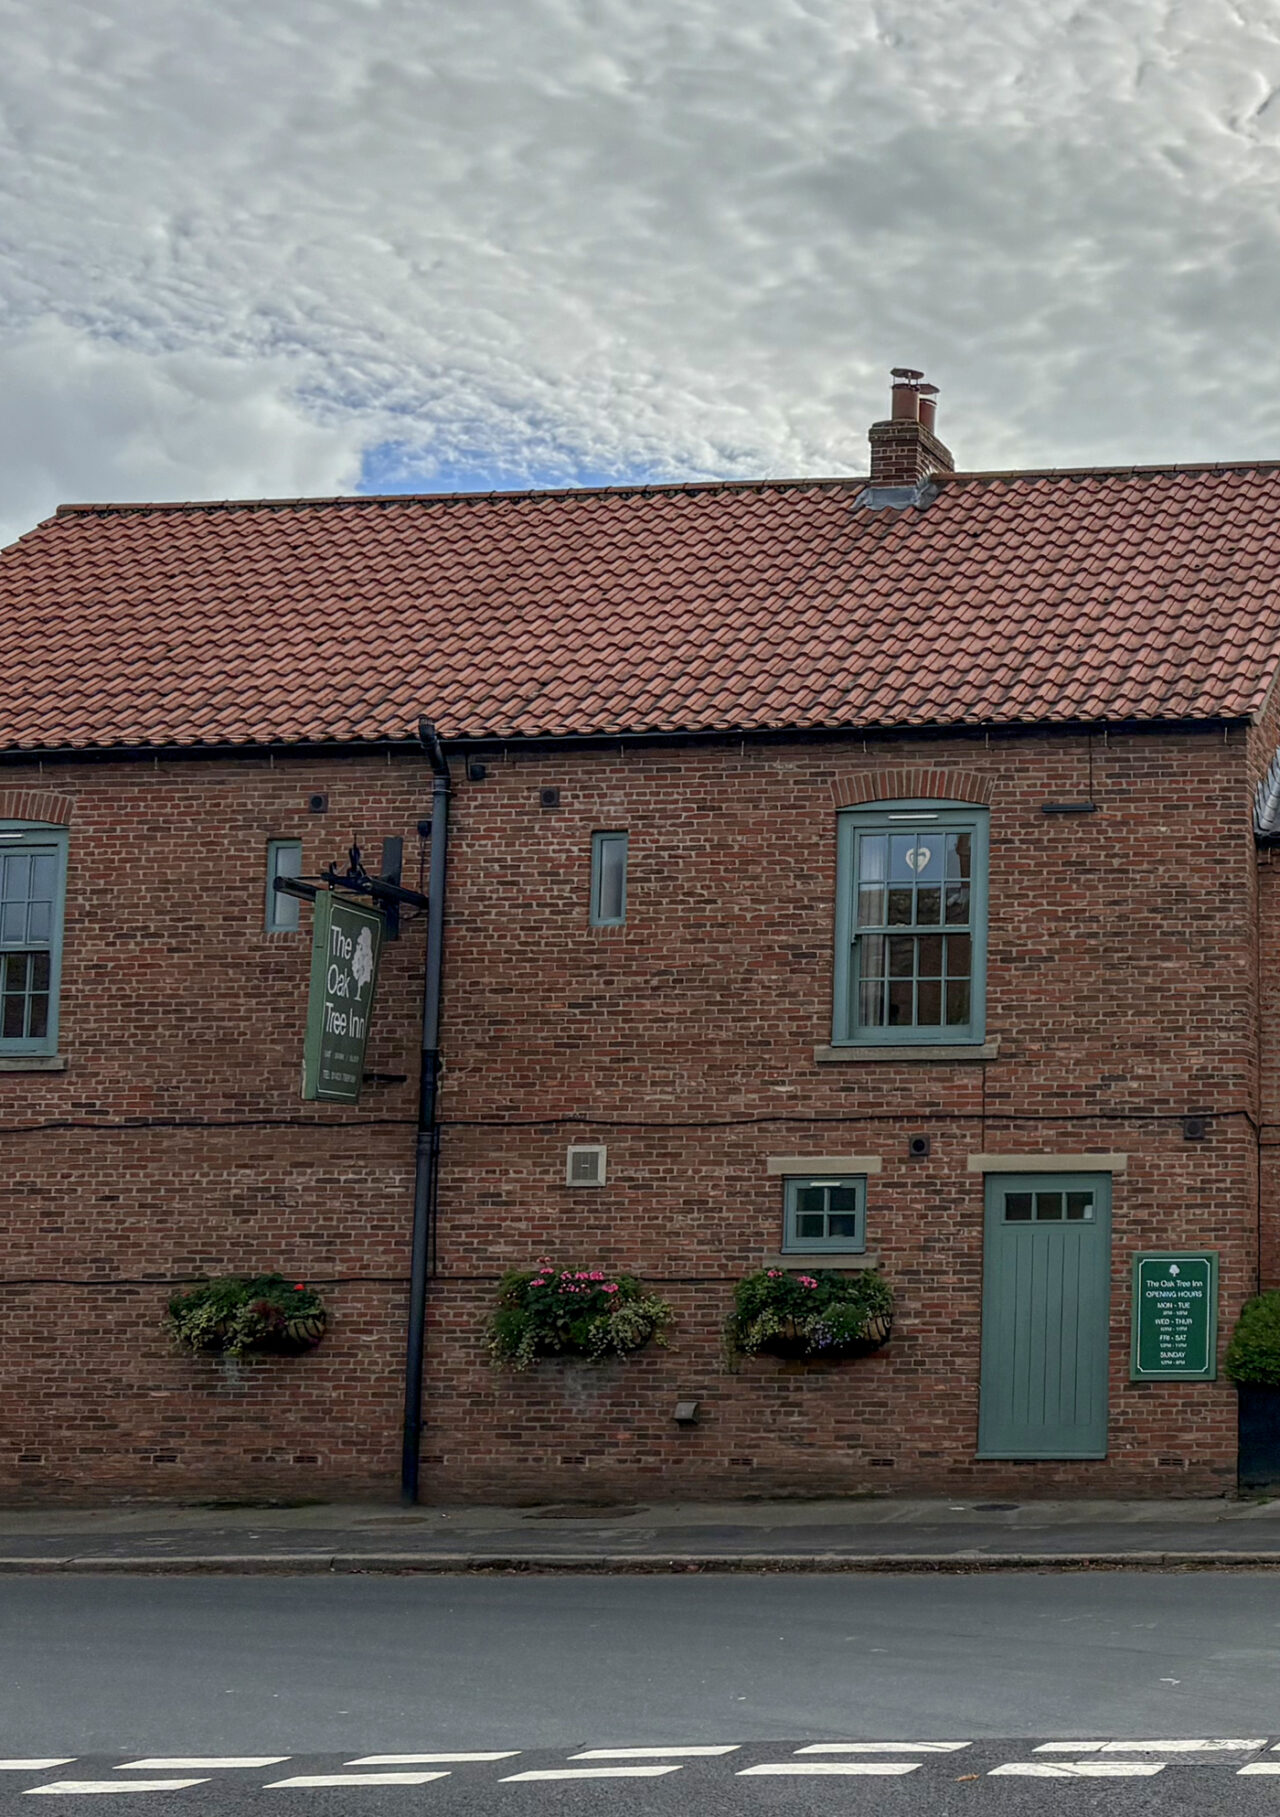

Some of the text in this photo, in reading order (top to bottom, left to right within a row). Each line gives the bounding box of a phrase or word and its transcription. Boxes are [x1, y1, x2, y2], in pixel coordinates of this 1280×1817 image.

[331, 926, 352, 960] The
[327, 964, 350, 998] Oak
[325, 1002, 365, 1040] Tree Inn
[1160, 1351, 1186, 1359] SUNDAY
